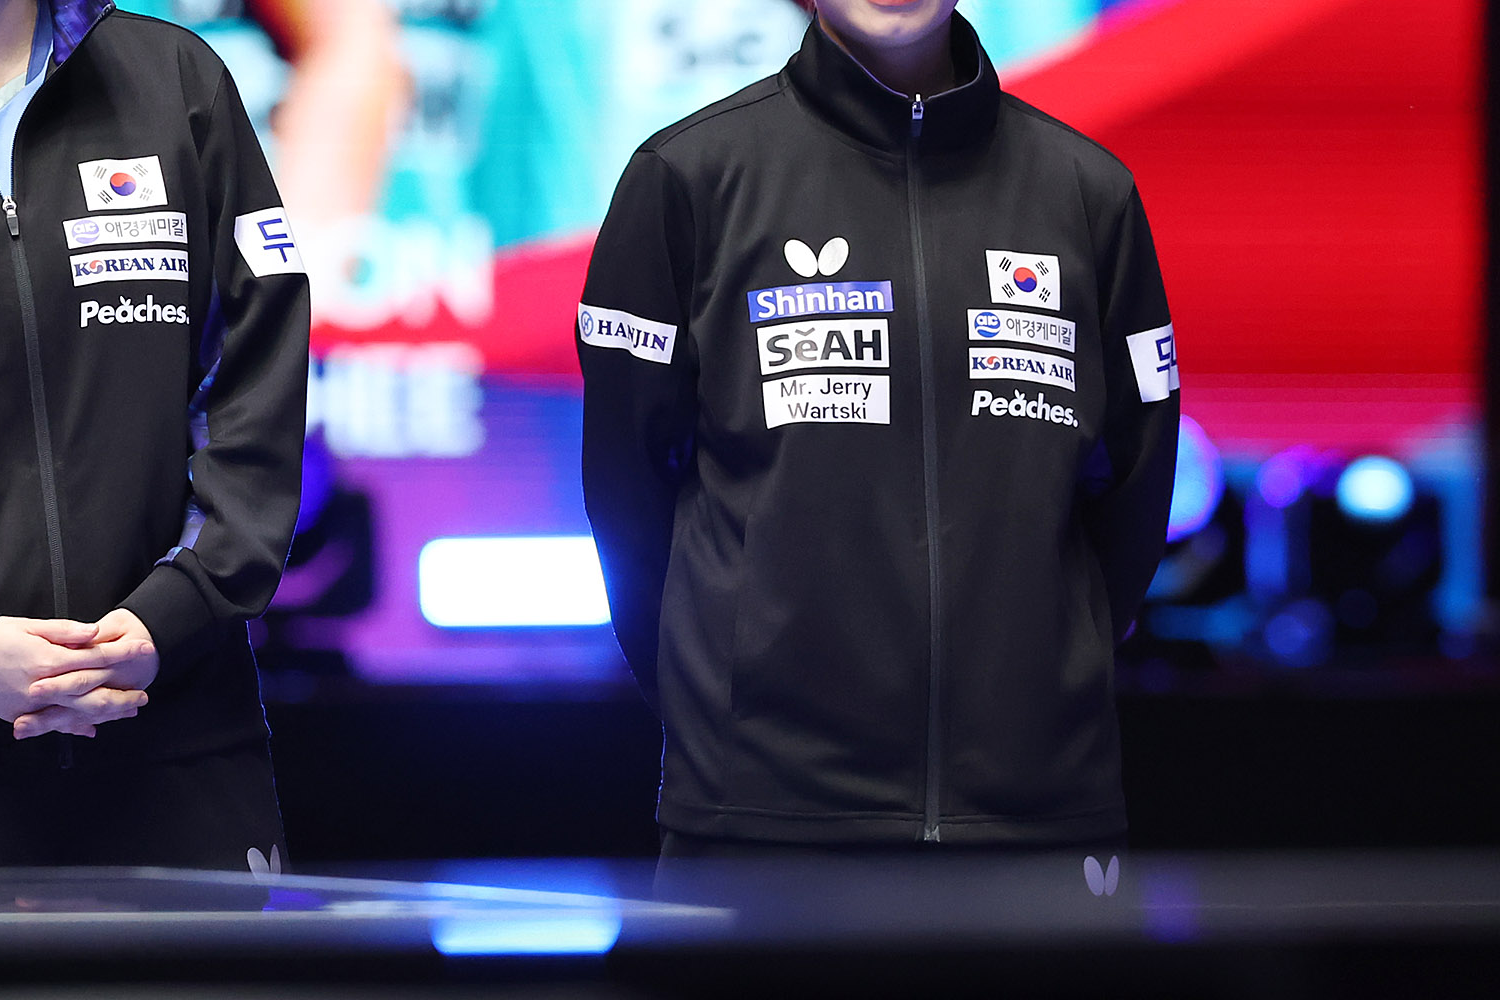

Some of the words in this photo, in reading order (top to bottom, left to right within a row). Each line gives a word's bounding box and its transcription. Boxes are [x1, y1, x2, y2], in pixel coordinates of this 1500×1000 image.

[104, 218, 184, 237] 애경케미칼
[74, 258, 155, 277] KOREAN
[159, 257, 189, 273] AIR
[756, 286, 885, 318] Shinhan
[597, 319, 668, 352] HANJIN
[1006, 318, 1072, 346] 애경케미칼
[971, 356, 1046, 375] KOREAN
[1049, 364, 1074, 383] AIR
[780, 380, 812, 398] Mr.
[820, 378, 872, 400] Jerry
[787, 401, 867, 420] Wartski
